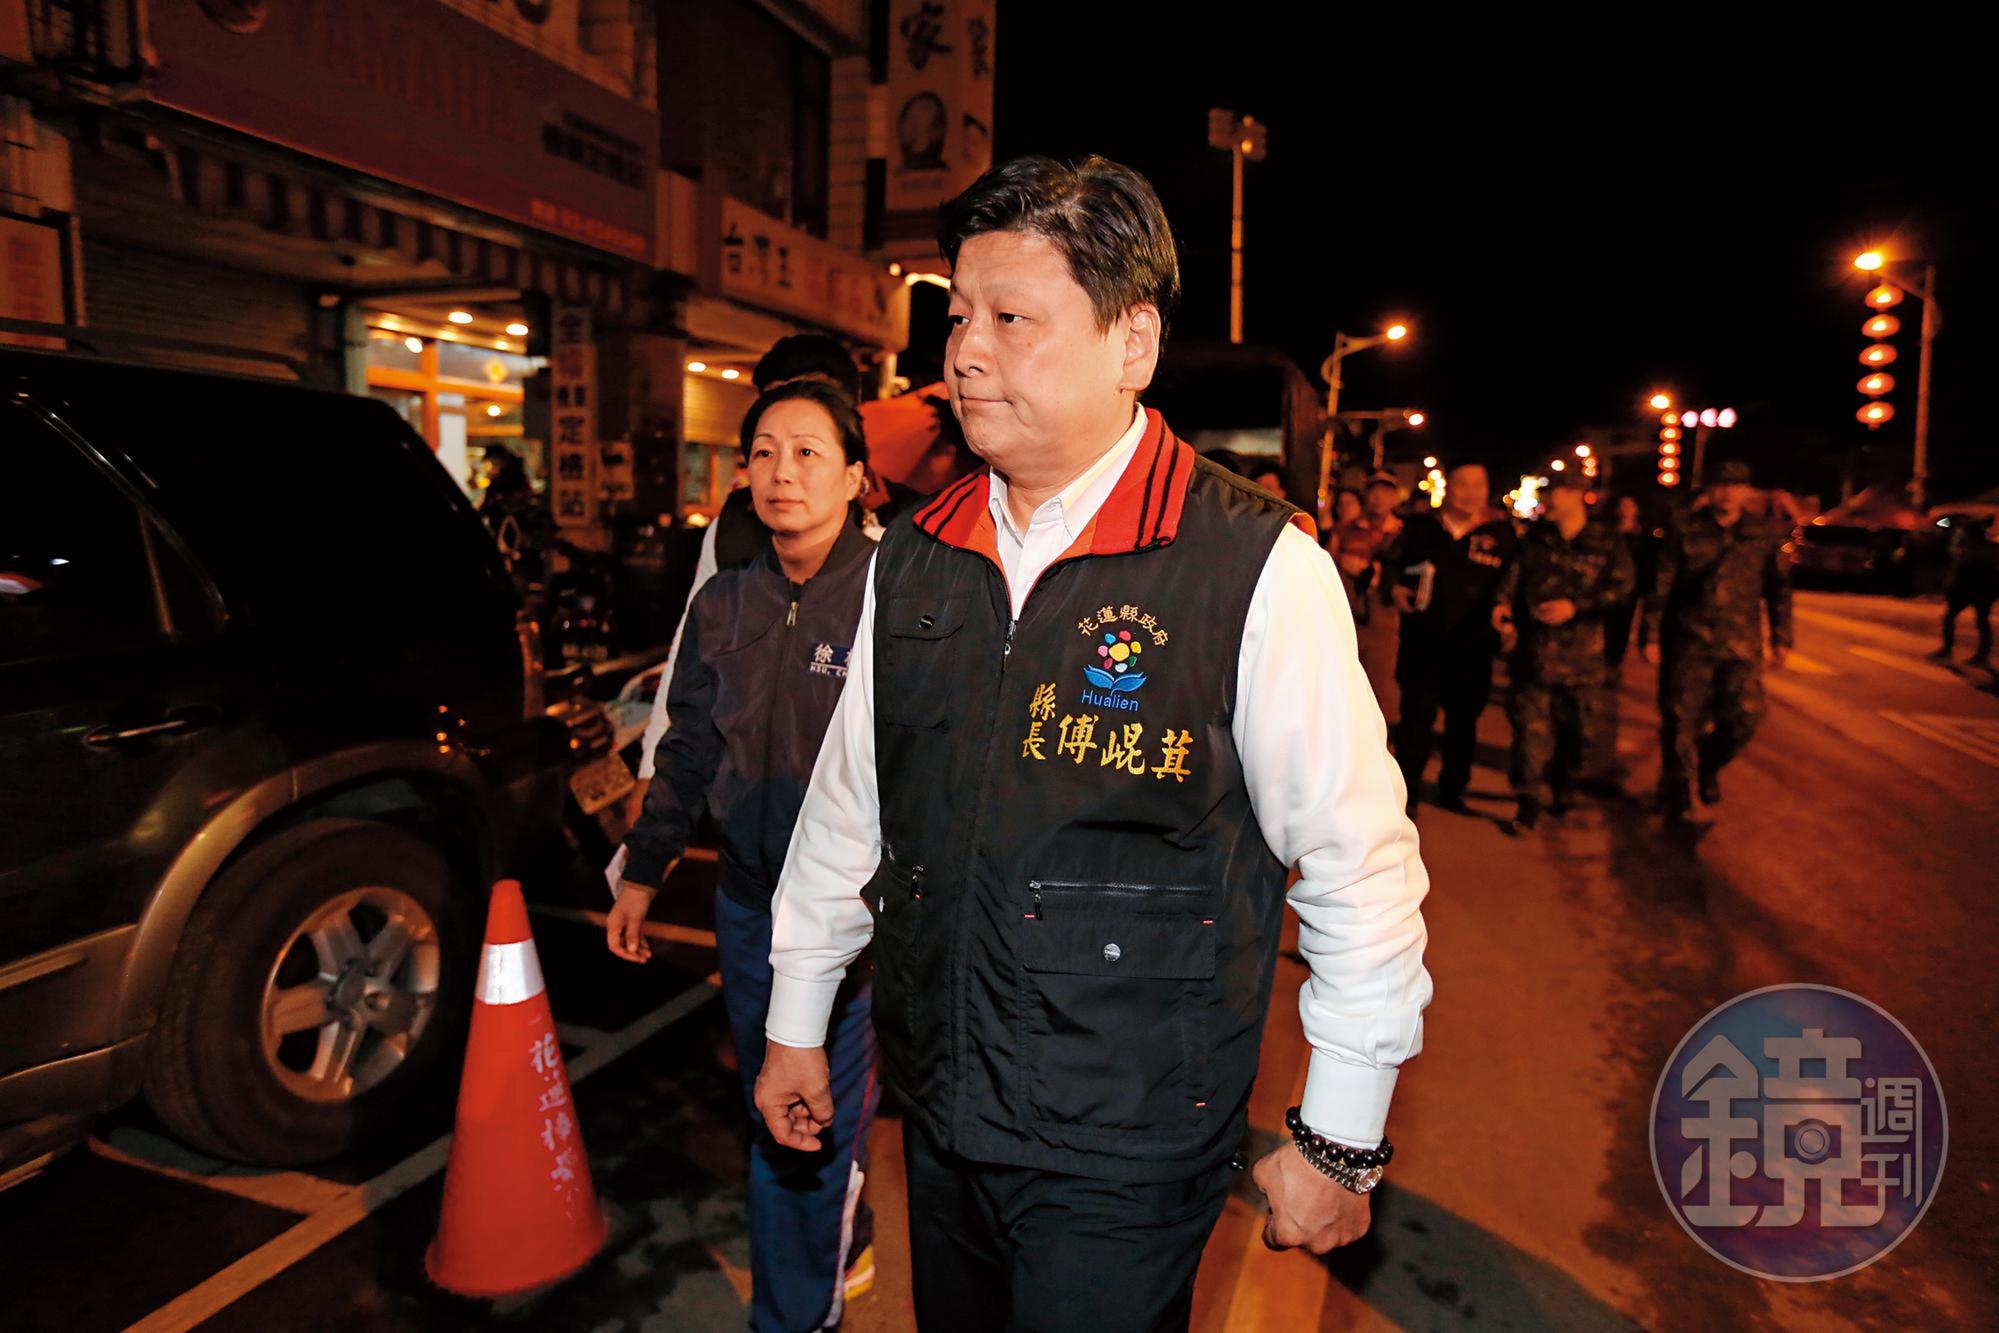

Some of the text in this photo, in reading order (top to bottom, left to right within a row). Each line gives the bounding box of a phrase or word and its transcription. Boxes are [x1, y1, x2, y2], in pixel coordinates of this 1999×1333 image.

[1077, 604, 1169, 647] 花蓮縣政府
[1022, 682, 1057, 760] 縣長
[1081, 689, 1139, 712] Hualien
